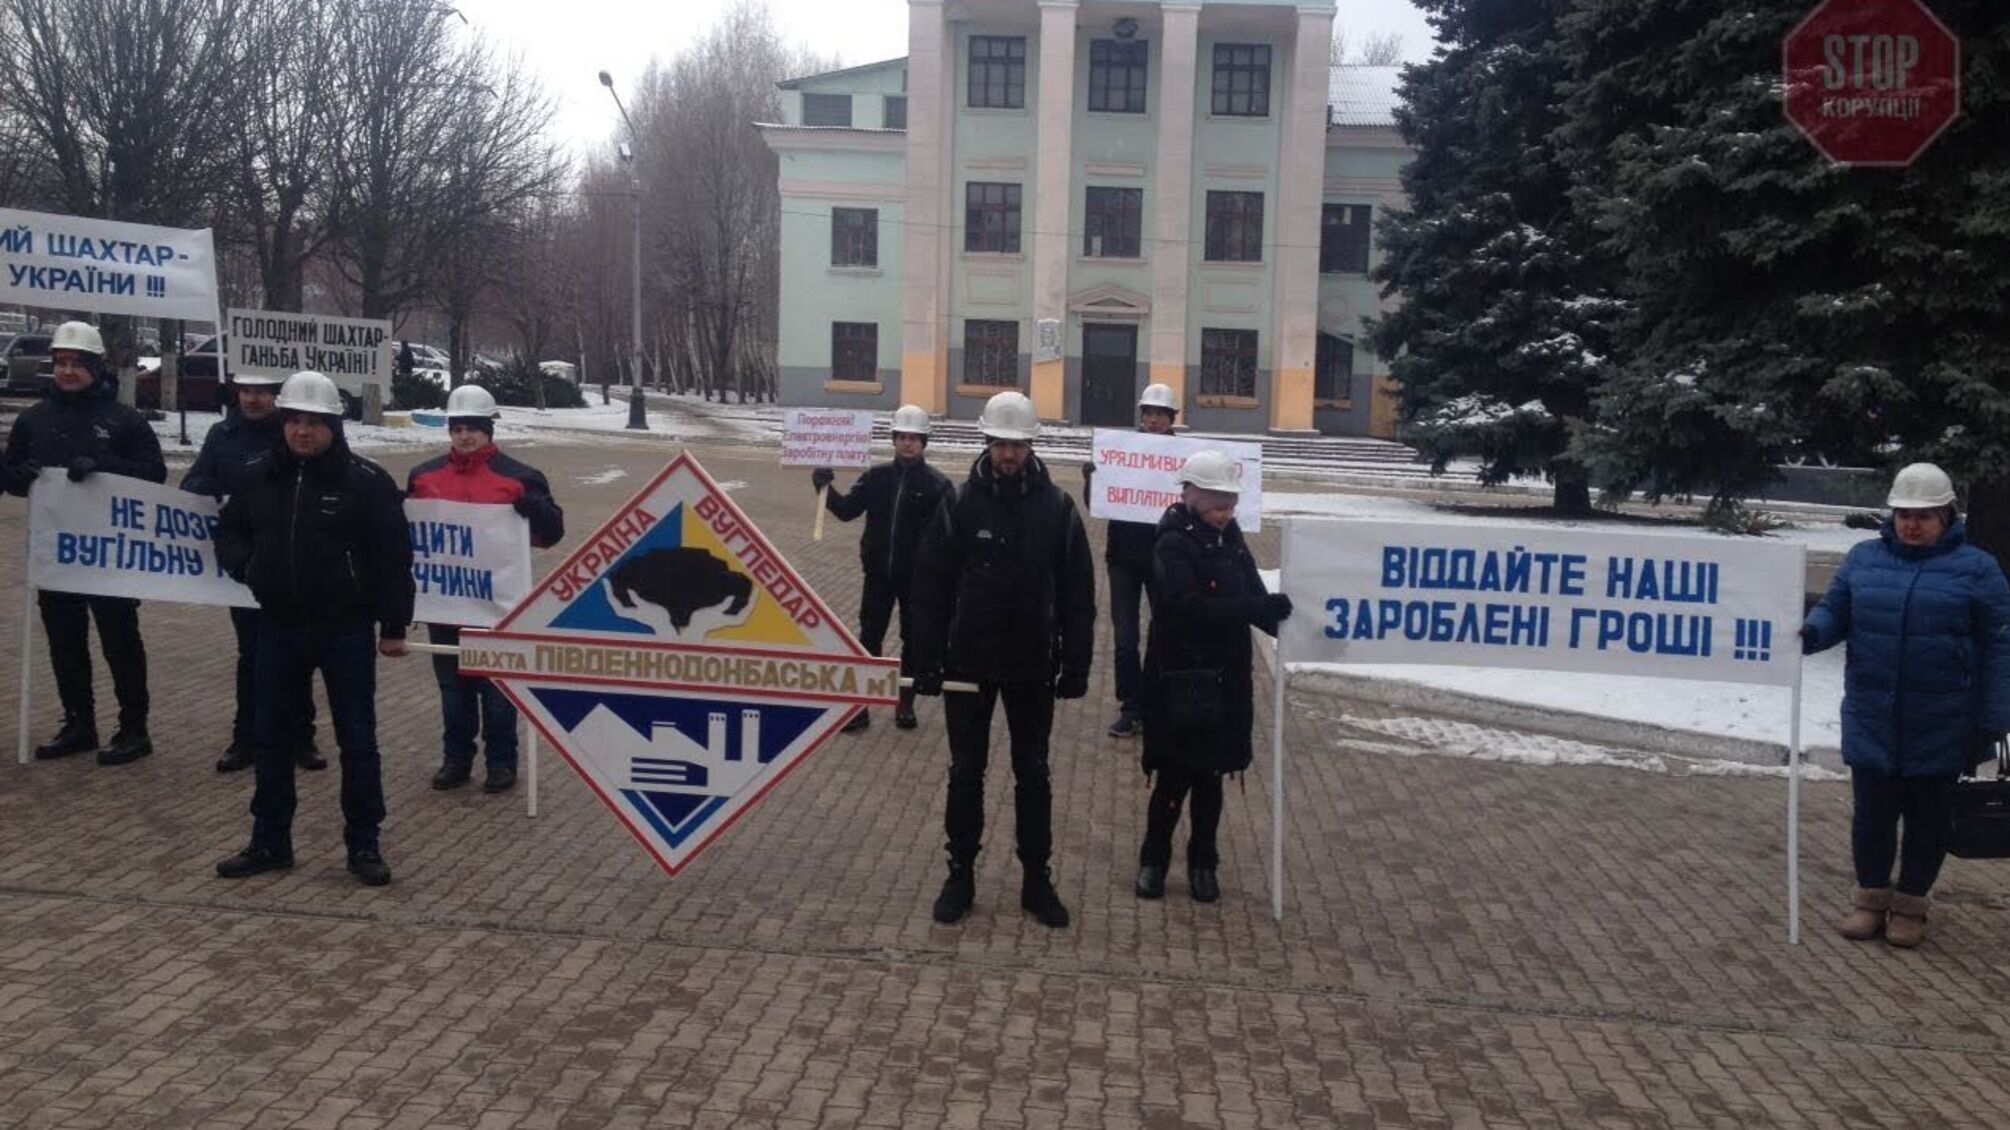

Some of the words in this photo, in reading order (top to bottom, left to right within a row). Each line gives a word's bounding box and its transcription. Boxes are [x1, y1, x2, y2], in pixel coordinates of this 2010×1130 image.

[8, 263, 135, 296] УКРАЇНИ
[146, 274, 166, 298] !!!
[232, 315, 318, 345] ГОЛОДНИЙ
[241, 343, 300, 370] ГАНЬБА
[111, 496, 145, 531] НЕ
[57, 532, 204, 578] ВУГІЛЬНУ
[550, 506, 658, 603] УКРАЇНА
[693, 494, 821, 630] ВУГЛЕДАР
[1380, 545, 1588, 596] ВІДДАЙТЕ
[1606, 556, 1720, 604] НАШІ
[1324, 597, 1550, 648] ЗАРОБЛЕНІ
[1568, 608, 1713, 658] ГРОШІ
[1733, 618, 1774, 662] !!!
[460, 648, 528, 671] ШАХТА
[534, 644, 860, 695] ПІВДЕННОДОНБАСЬКА
